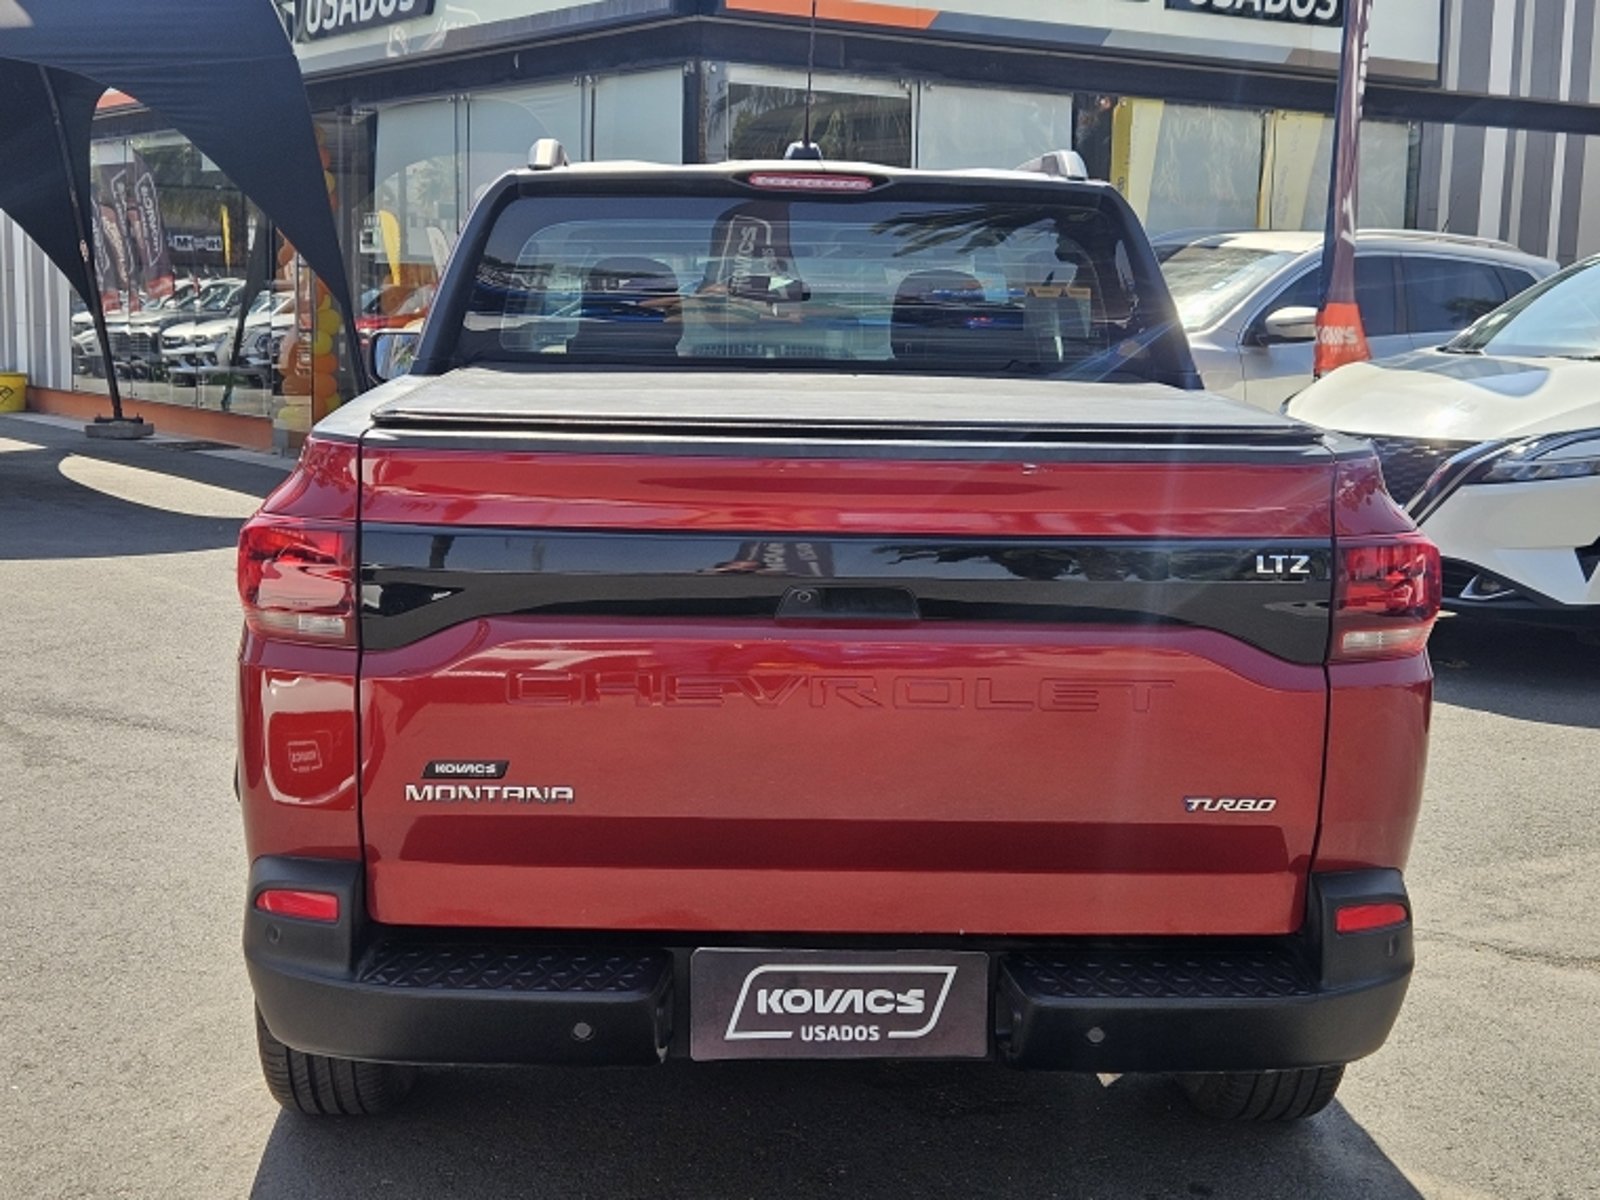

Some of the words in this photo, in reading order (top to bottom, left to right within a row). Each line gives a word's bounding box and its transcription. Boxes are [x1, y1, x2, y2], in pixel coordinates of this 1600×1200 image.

[306, 0, 416, 34] USA
[1256, 555, 1310, 573] LTZ
[505, 669, 1176, 713] CHEVROLET
[434, 763, 496, 774] KOVACS
[405, 784, 576, 803] MONTANA
[1185, 798, 1277, 812] TURBO
[757, 989, 925, 1014] KOVACS
[800, 1025, 881, 1041] USADOS
